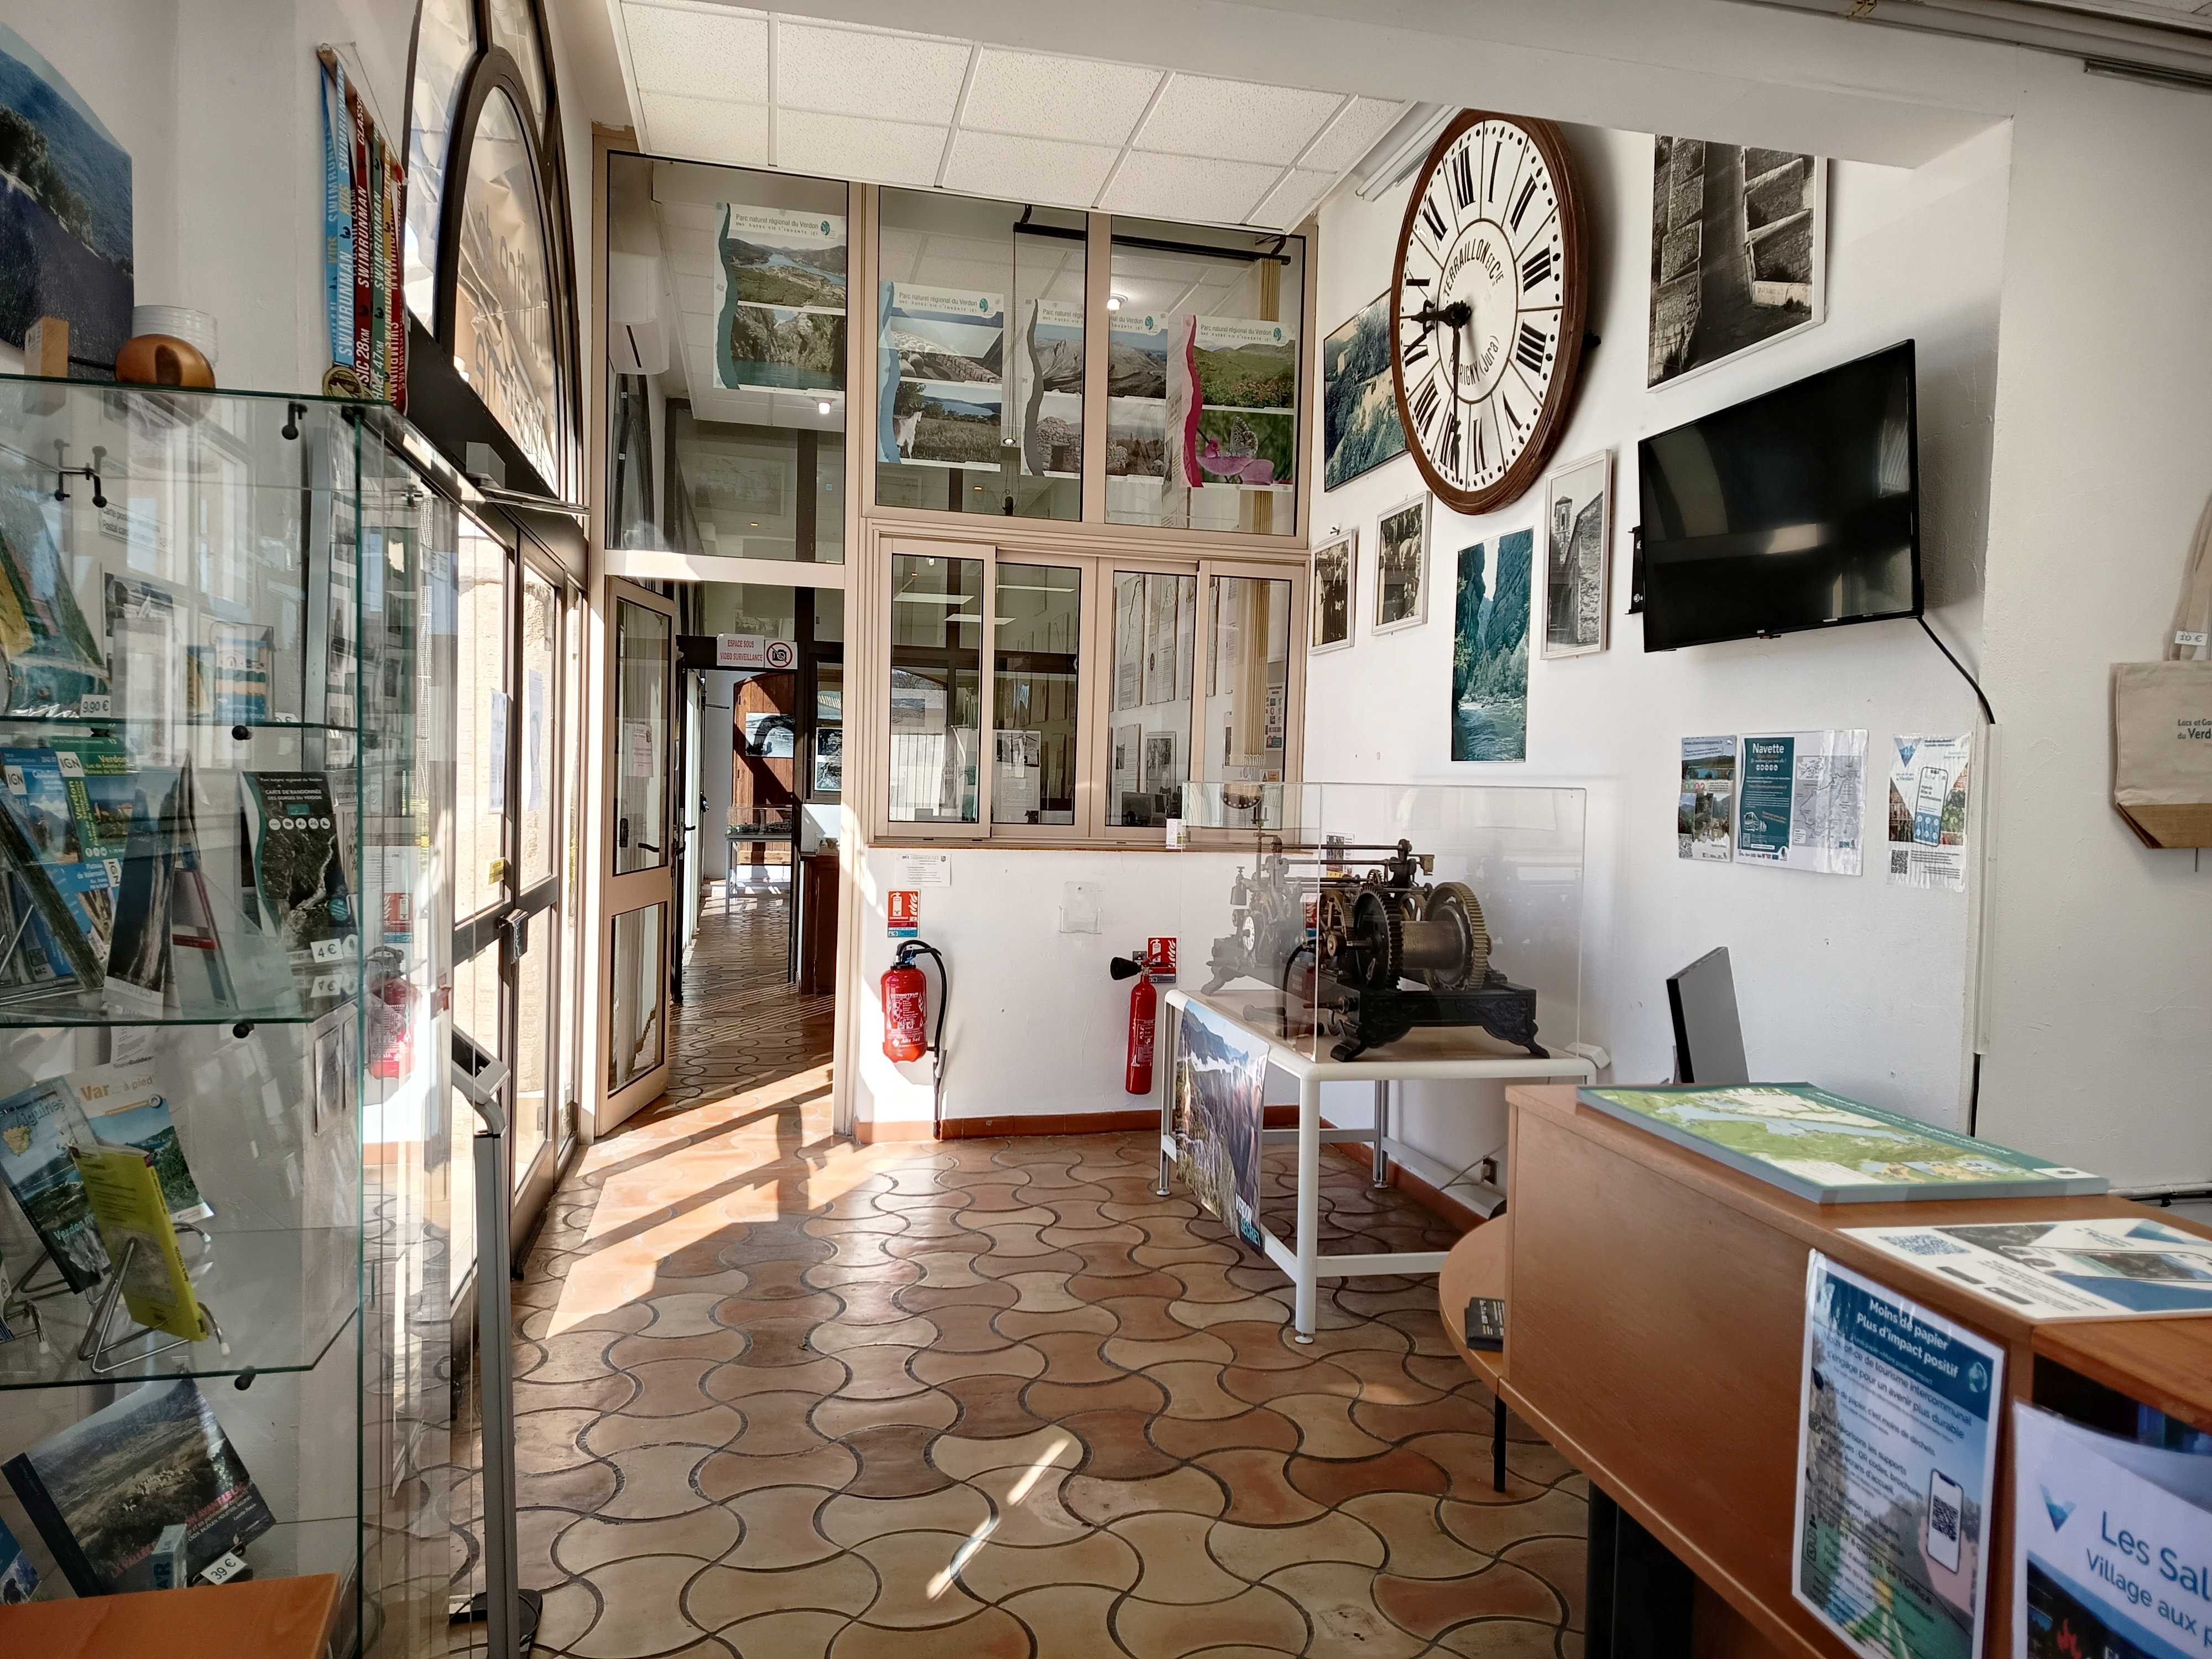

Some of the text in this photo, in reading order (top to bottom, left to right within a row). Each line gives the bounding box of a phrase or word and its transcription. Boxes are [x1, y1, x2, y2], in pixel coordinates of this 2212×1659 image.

[338, 184, 351, 216] KIDS
[1510, 173, 1538, 236] II
[736, 213, 748, 222] Parc
[769, 218, 790, 228] régional
[800, 221, 818, 229] Verdon
[358, 186, 370, 288] SWIMRUNMAN
[373, 191, 384, 290] SWIMRUNMAN
[1443, 238, 1495, 296] TERRAILLON ET
[1522, 243, 1551, 295] III
[338, 251, 353, 356] SWIMRUNMAN
[930, 296, 951, 305] régional
[357, 327, 370, 358] 28KM
[373, 340, 384, 369] 47KM
[1479, 335, 1499, 376] (Jura)
[1516, 319, 1547, 376] IIII
[727, 639, 743, 648] ESPACE
[733, 653, 763, 661] SURVEILLANCE
[82, 699, 109, 712] 9.90 €
[98, 755, 129, 763] Verdon
[1752, 743, 1785, 754] Navette
[59, 758, 81, 769] IGN
[9, 773, 23, 785] IGN
[69, 781, 83, 820] Verdon
[108, 860, 120, 884] IGN
[317, 943, 337, 958] 4 €
[80, 1077, 153, 1101] Var à pied
[15, 1099, 66, 1126] Aiguines
[1235, 1192, 1253, 1227] VERDON
[53, 1222, 84, 1241] Verdon
[1240, 1217, 1261, 1247] SECRET
[1870, 1300, 1949, 1350] Moins de papier
[1857, 1312, 1959, 1378] Plus d'impact positif
[1827, 1350, 1964, 1439] s'engage pour un avenir plus durable
[1864, 1355, 1875, 1368] de
[1875, 1361, 1909, 1388] tourisme
[1910, 1381, 1972, 1427] intercommunal
[1882, 1417, 1900, 1434] moins
[1900, 1429, 1909, 1439] de
[1858, 1449, 1868, 1462] QR
[1877, 1451, 1907, 1477] supports
[2101, 1510, 2151, 1567] Les
[210, 1558, 237, 1580] 39 €
[1885, 1564, 1896, 1577] de
[2086, 1548, 2198, 1636] Village aux
